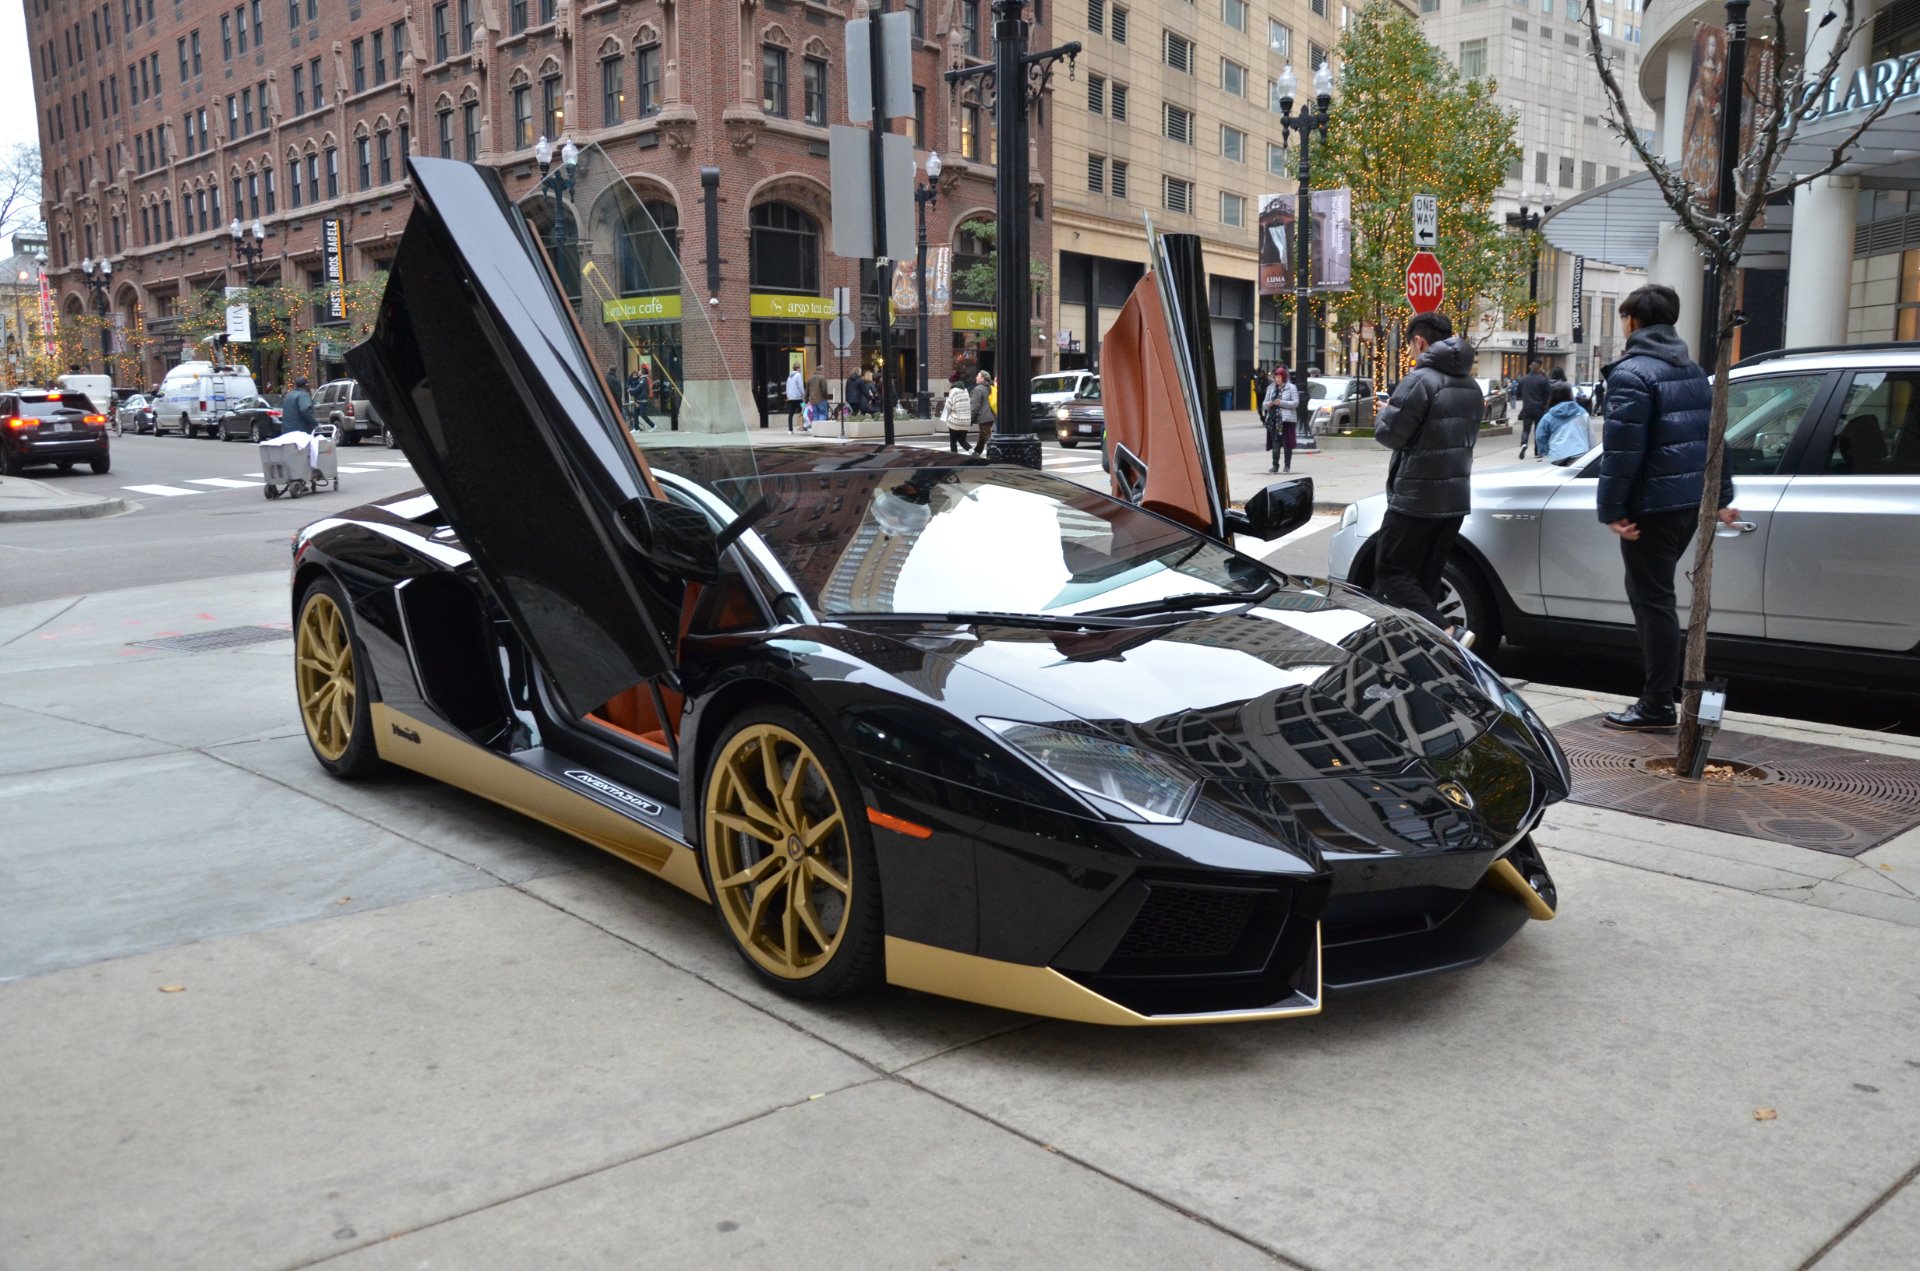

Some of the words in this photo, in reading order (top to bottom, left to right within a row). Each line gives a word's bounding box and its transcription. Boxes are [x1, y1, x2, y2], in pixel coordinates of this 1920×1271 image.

[1416, 199, 1434, 212] ONE
[1416, 213, 1434, 226] WAY
[326, 221, 338, 253] BAGELS
[1409, 272, 1442, 297] STOP
[1572, 257, 1581, 306] NORDSTROM
[638, 297, 663, 314] café
[788, 302, 809, 316] argo
[811, 302, 822, 314] tea
[1572, 308, 1581, 329] rack
[577, 775, 651, 808] AVENTADOR
